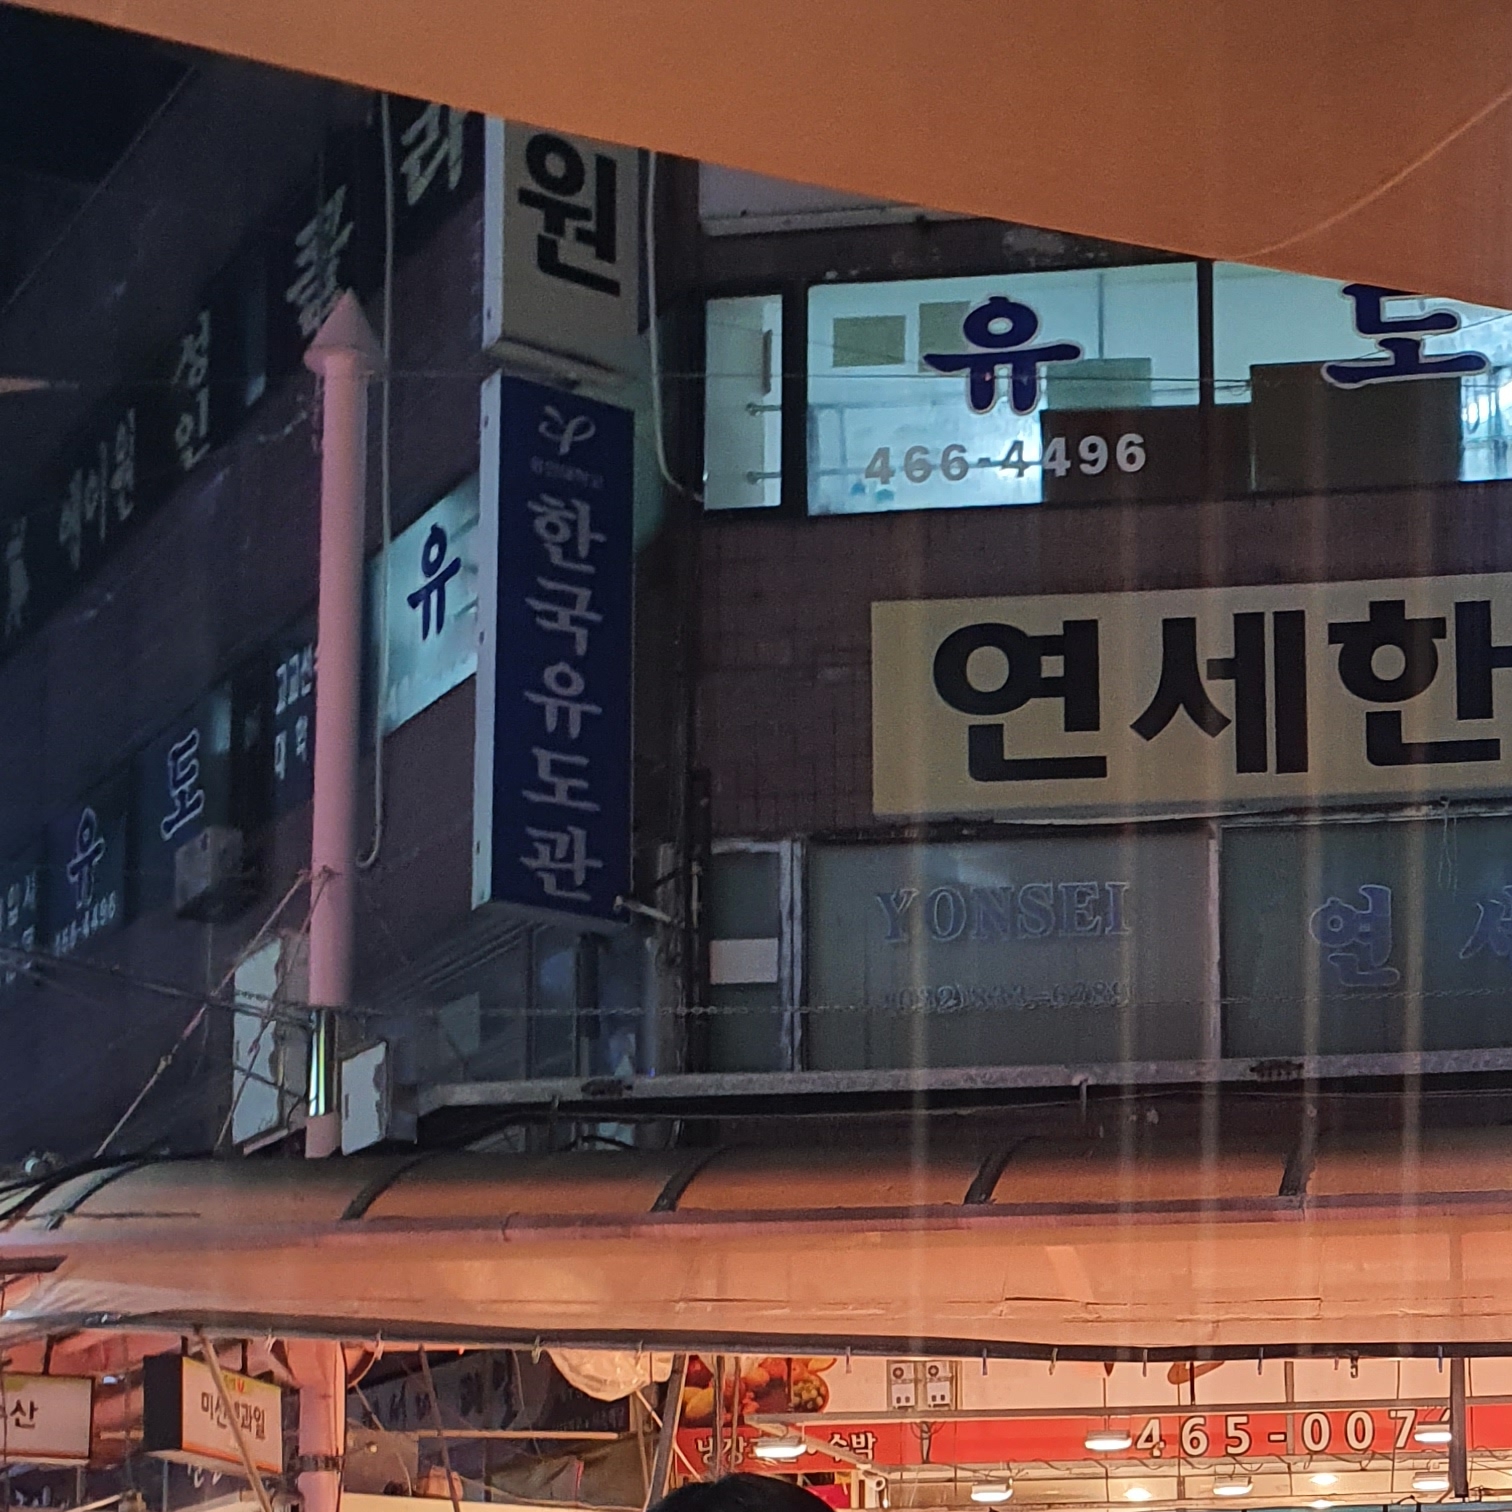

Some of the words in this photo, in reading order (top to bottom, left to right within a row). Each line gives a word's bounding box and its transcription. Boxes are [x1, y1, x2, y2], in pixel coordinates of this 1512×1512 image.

[864, 432, 1147, 486] 466-4496
[520, 494, 608, 901] 한국유도관
[875, 881, 1132, 944] YONSEI
